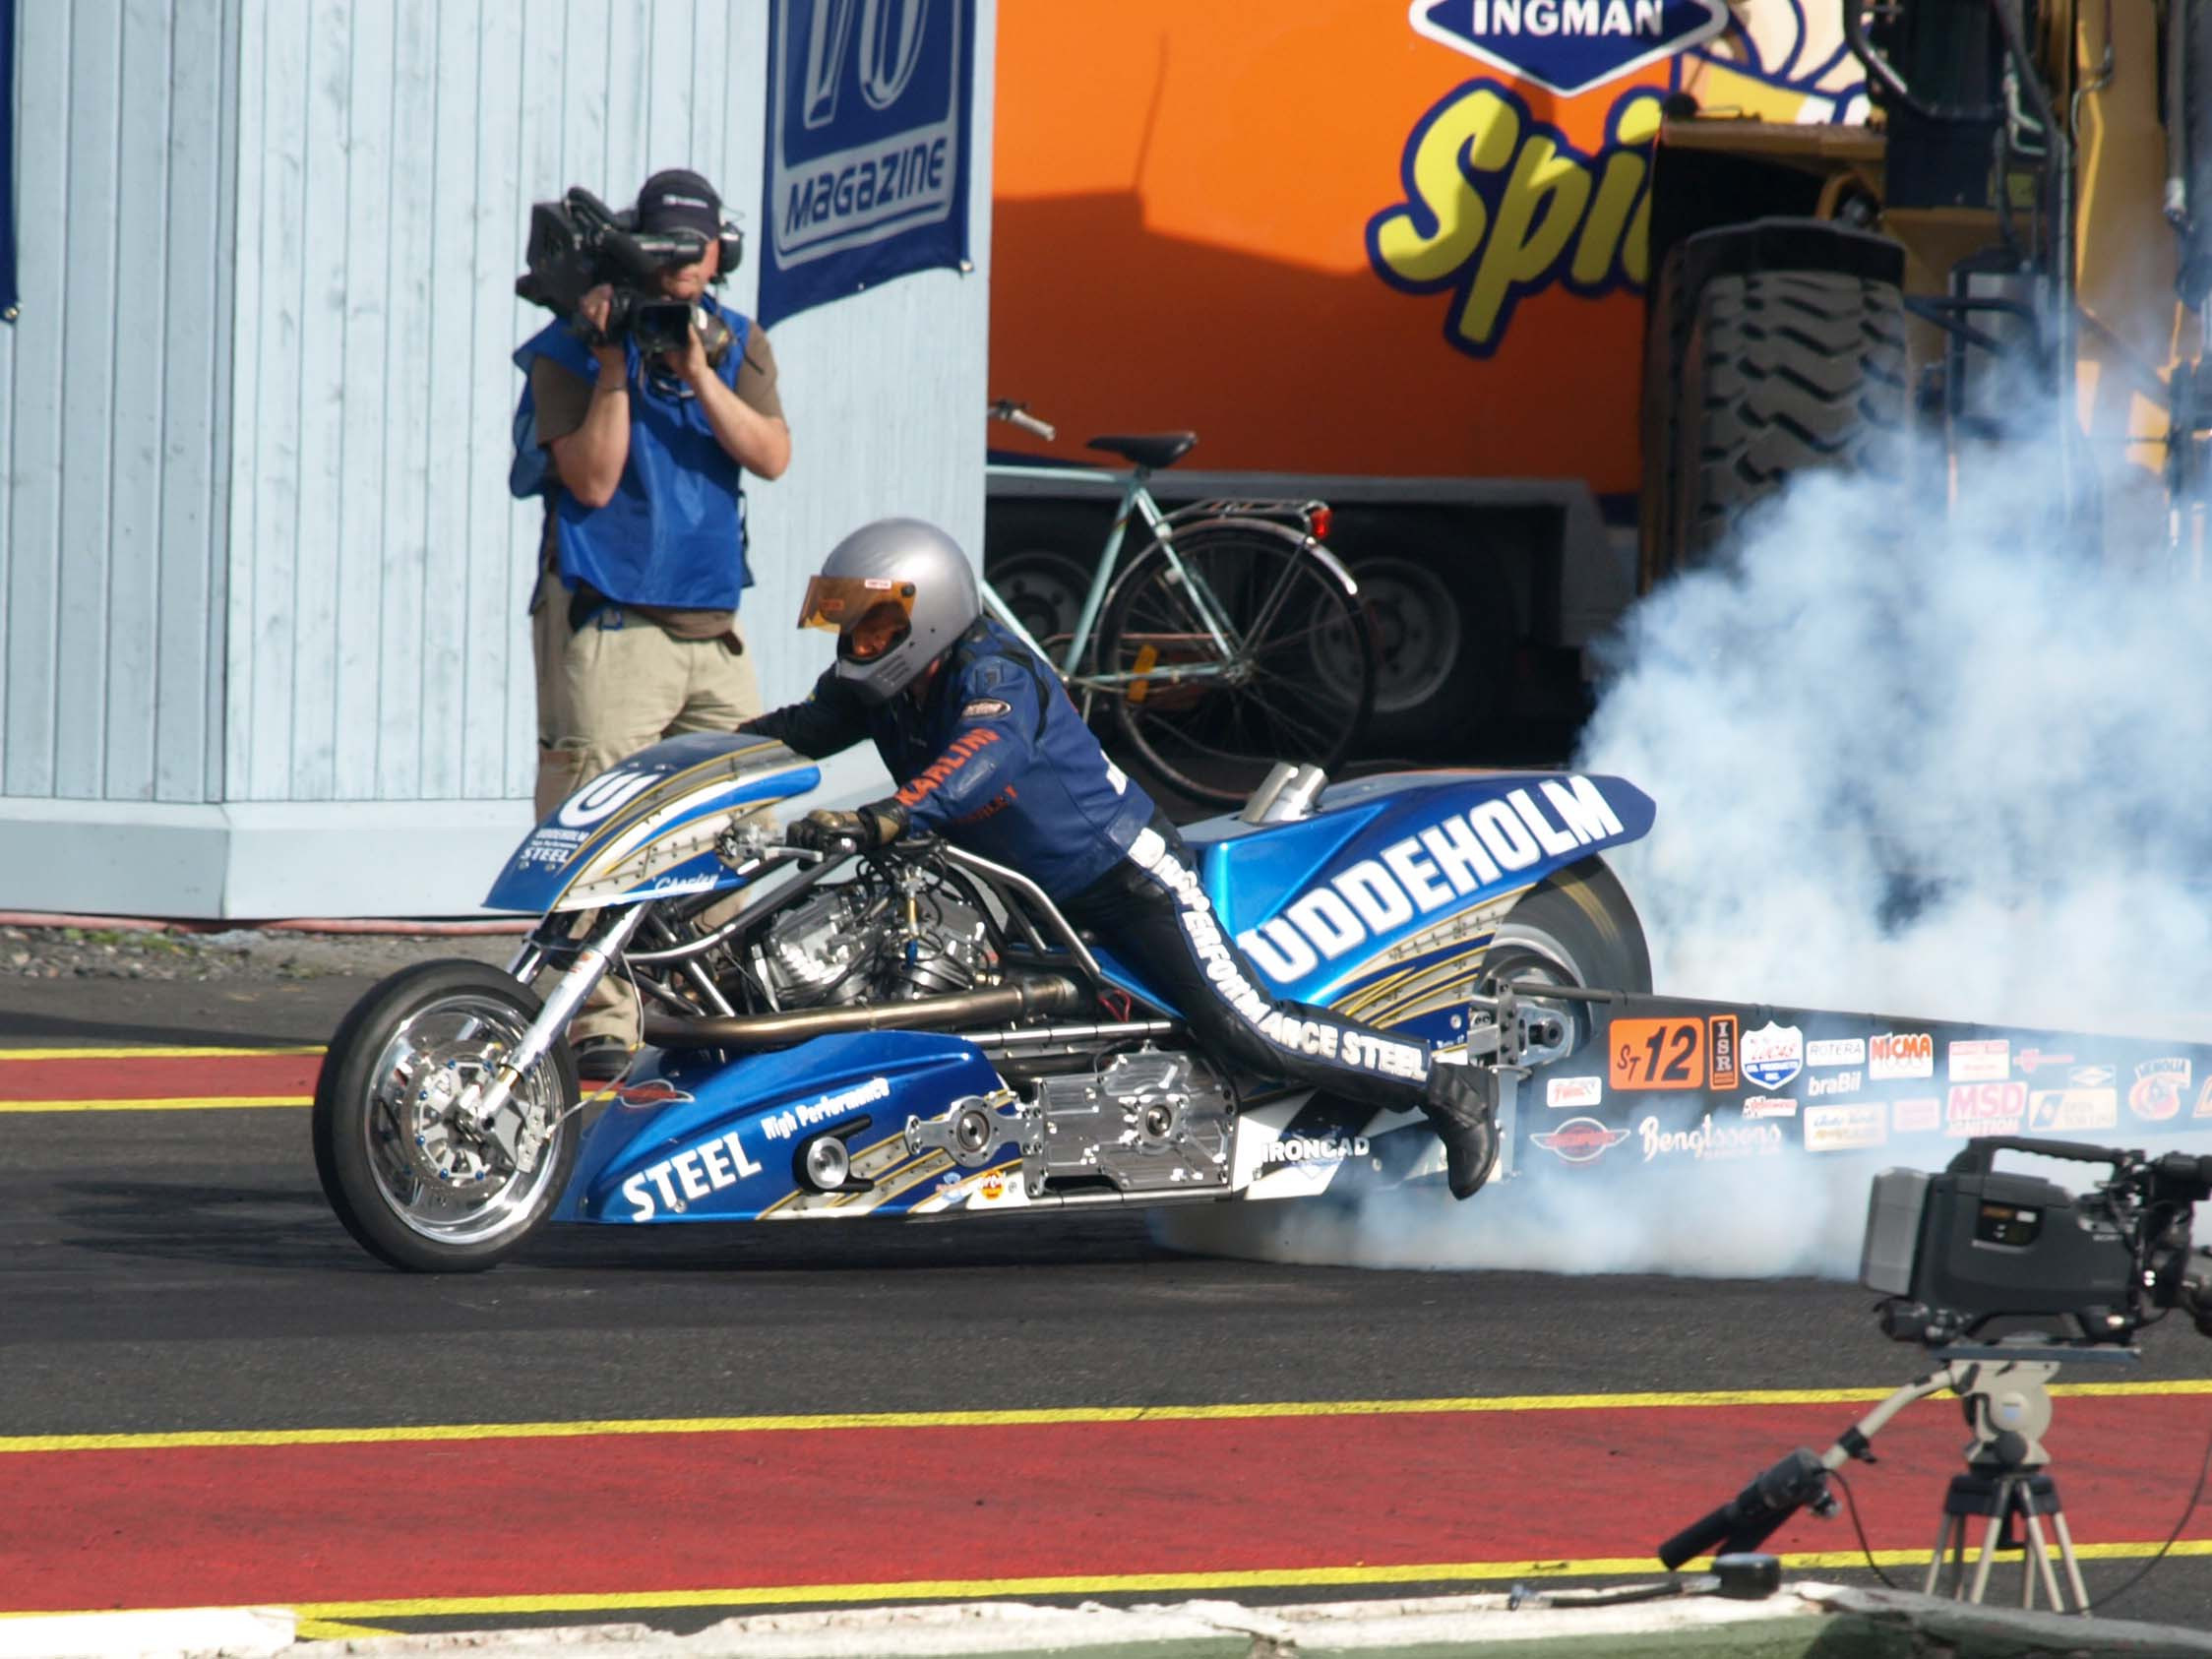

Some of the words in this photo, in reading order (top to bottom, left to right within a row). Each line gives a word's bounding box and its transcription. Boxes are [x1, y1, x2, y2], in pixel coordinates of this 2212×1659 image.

[1472, 0, 1663, 36] INGMAN
[1236, 774, 1625, 983] UDDEHOLM
[1340, 1031, 1428, 1082] STEEL
[1644, 1024, 1697, 1081] 12
[1715, 1020, 1733, 1073] ISR
[1949, 1083, 2025, 1122] MSD
[1261, 1137, 1371, 1163] IRONCAD
[622, 1131, 763, 1222] STEEL
